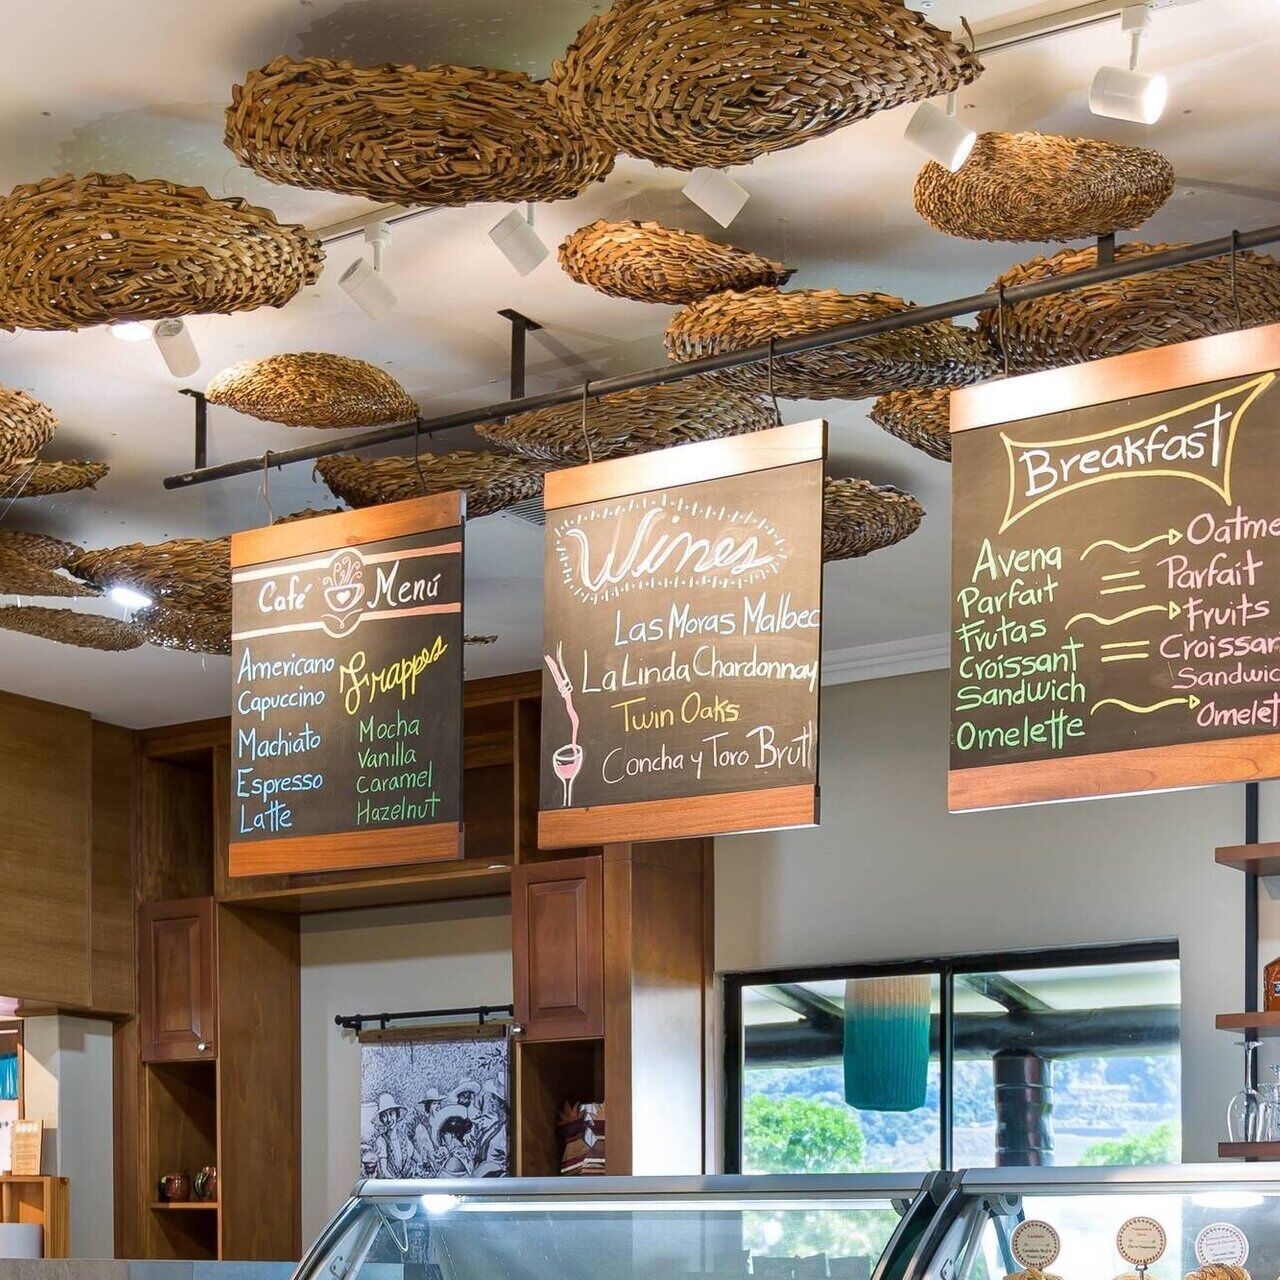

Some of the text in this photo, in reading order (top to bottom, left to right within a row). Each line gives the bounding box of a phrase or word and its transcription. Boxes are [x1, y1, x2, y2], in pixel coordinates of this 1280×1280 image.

[1019, 403, 1234, 497] Breakfast
[566, 508, 772, 591] Wines
[972, 538, 1062, 583] Avena
[258, 560, 442, 613] Café Menú
[1157, 550, 1264, 590] Parfait
[957, 580, 1059, 618] Parfait
[1182, 593, 1270, 631] Fruits
[615, 592, 821, 646] Las Moras Malbec
[955, 616, 1047, 654] Frutas
[237, 647, 335, 684] Americano
[582, 644, 819, 694] La Linda Chardonnay
[960, 638, 1084, 679] Croissant
[237, 685, 325, 721] Capuccino
[611, 691, 740, 732] Twin Oaks
[955, 674, 1086, 711] Sandwich
[238, 722, 321, 761] Machiato
[359, 709, 420, 743] Mocha
[957, 712, 1086, 750] Omelette
[357, 738, 417, 769] Vanilla
[603, 744, 684, 784] Concha
[690, 752, 704, 779] y
[702, 732, 750, 768] Toro
[237, 768, 323, 802] Espresso
[356, 761, 432, 794] Caramel
[240, 801, 293, 833] Latte
[357, 792, 441, 826] Hazelnut
